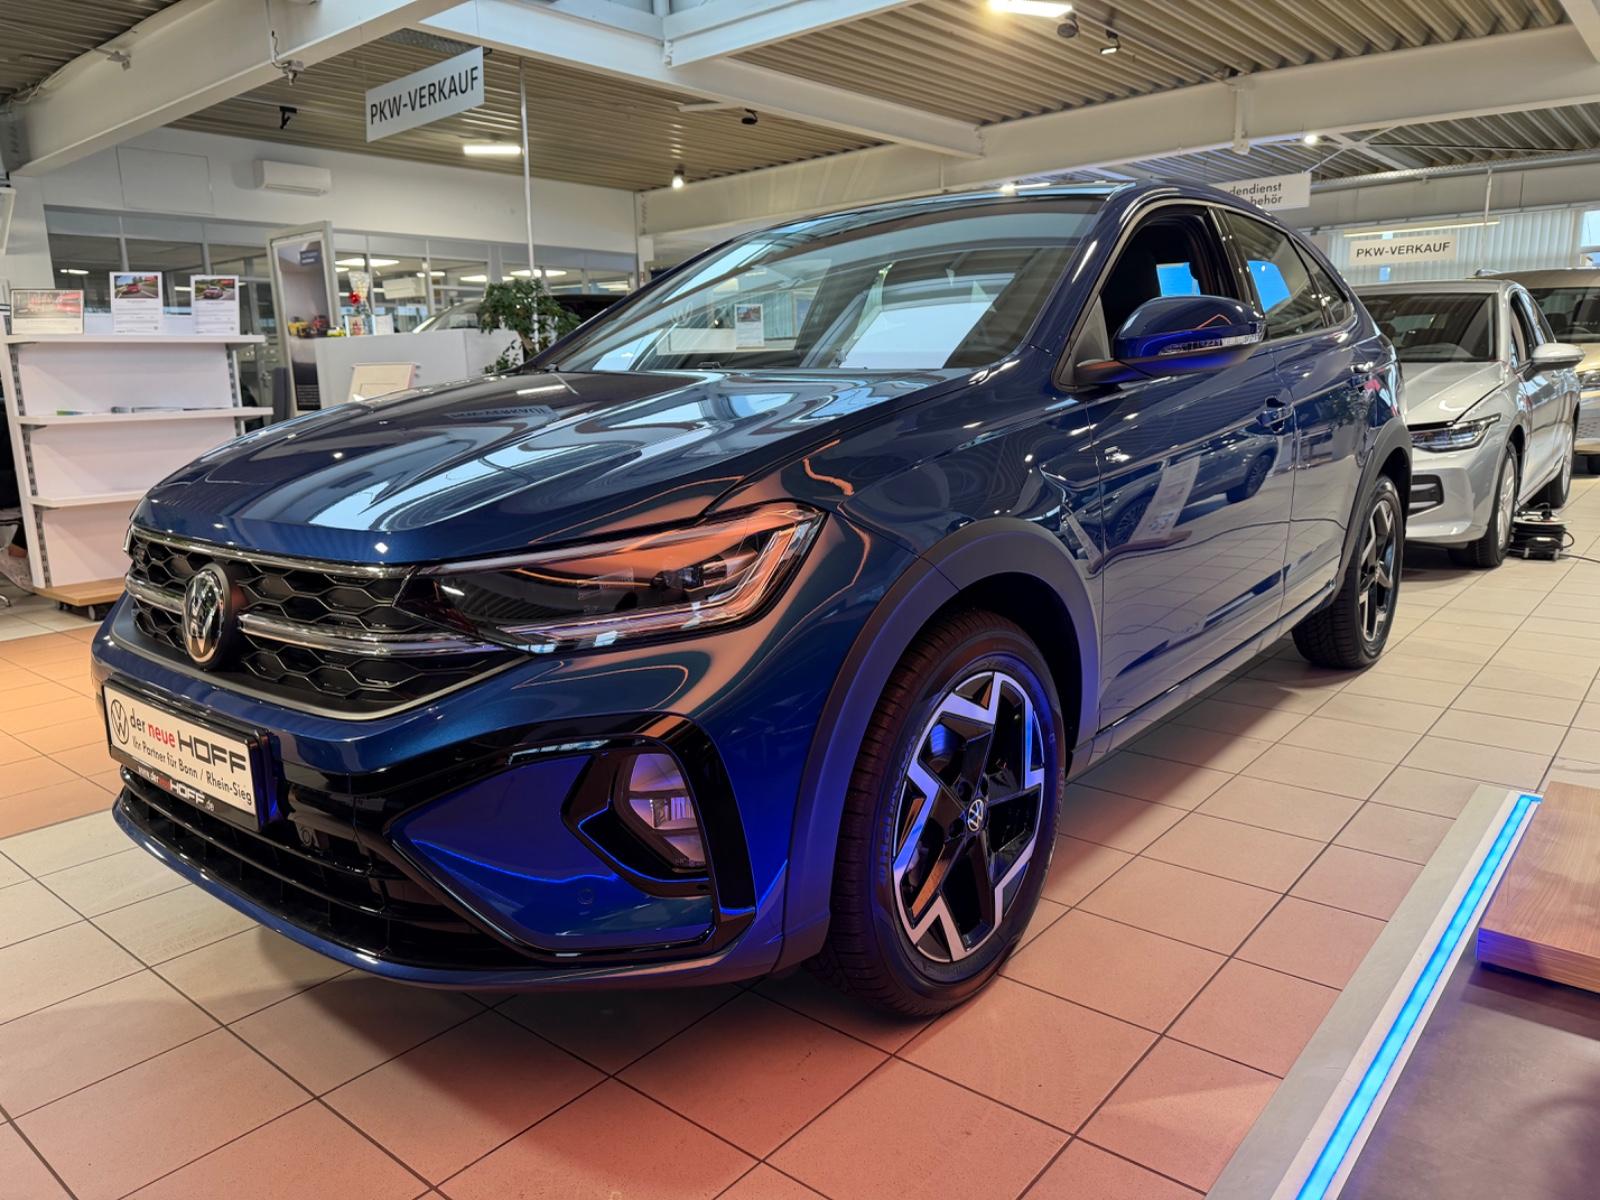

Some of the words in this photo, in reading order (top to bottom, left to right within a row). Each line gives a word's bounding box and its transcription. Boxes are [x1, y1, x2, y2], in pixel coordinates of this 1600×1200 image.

[370, 65, 478, 125] PKW-VERKAUF
[1229, 183, 1282, 196] dendienst
[1250, 193, 1282, 205] behör
[1356, 241, 1450, 258] PKW-VERKAUF
[130, 707, 146, 733] der
[148, 722, 176, 749] neue
[177, 729, 247, 774] HOFF
[142, 740, 166, 764] Partner
[166, 751, 177, 769] für
[178, 758, 198, 779] Bonn
[206, 770, 252, 806] Rhein-Sieg
